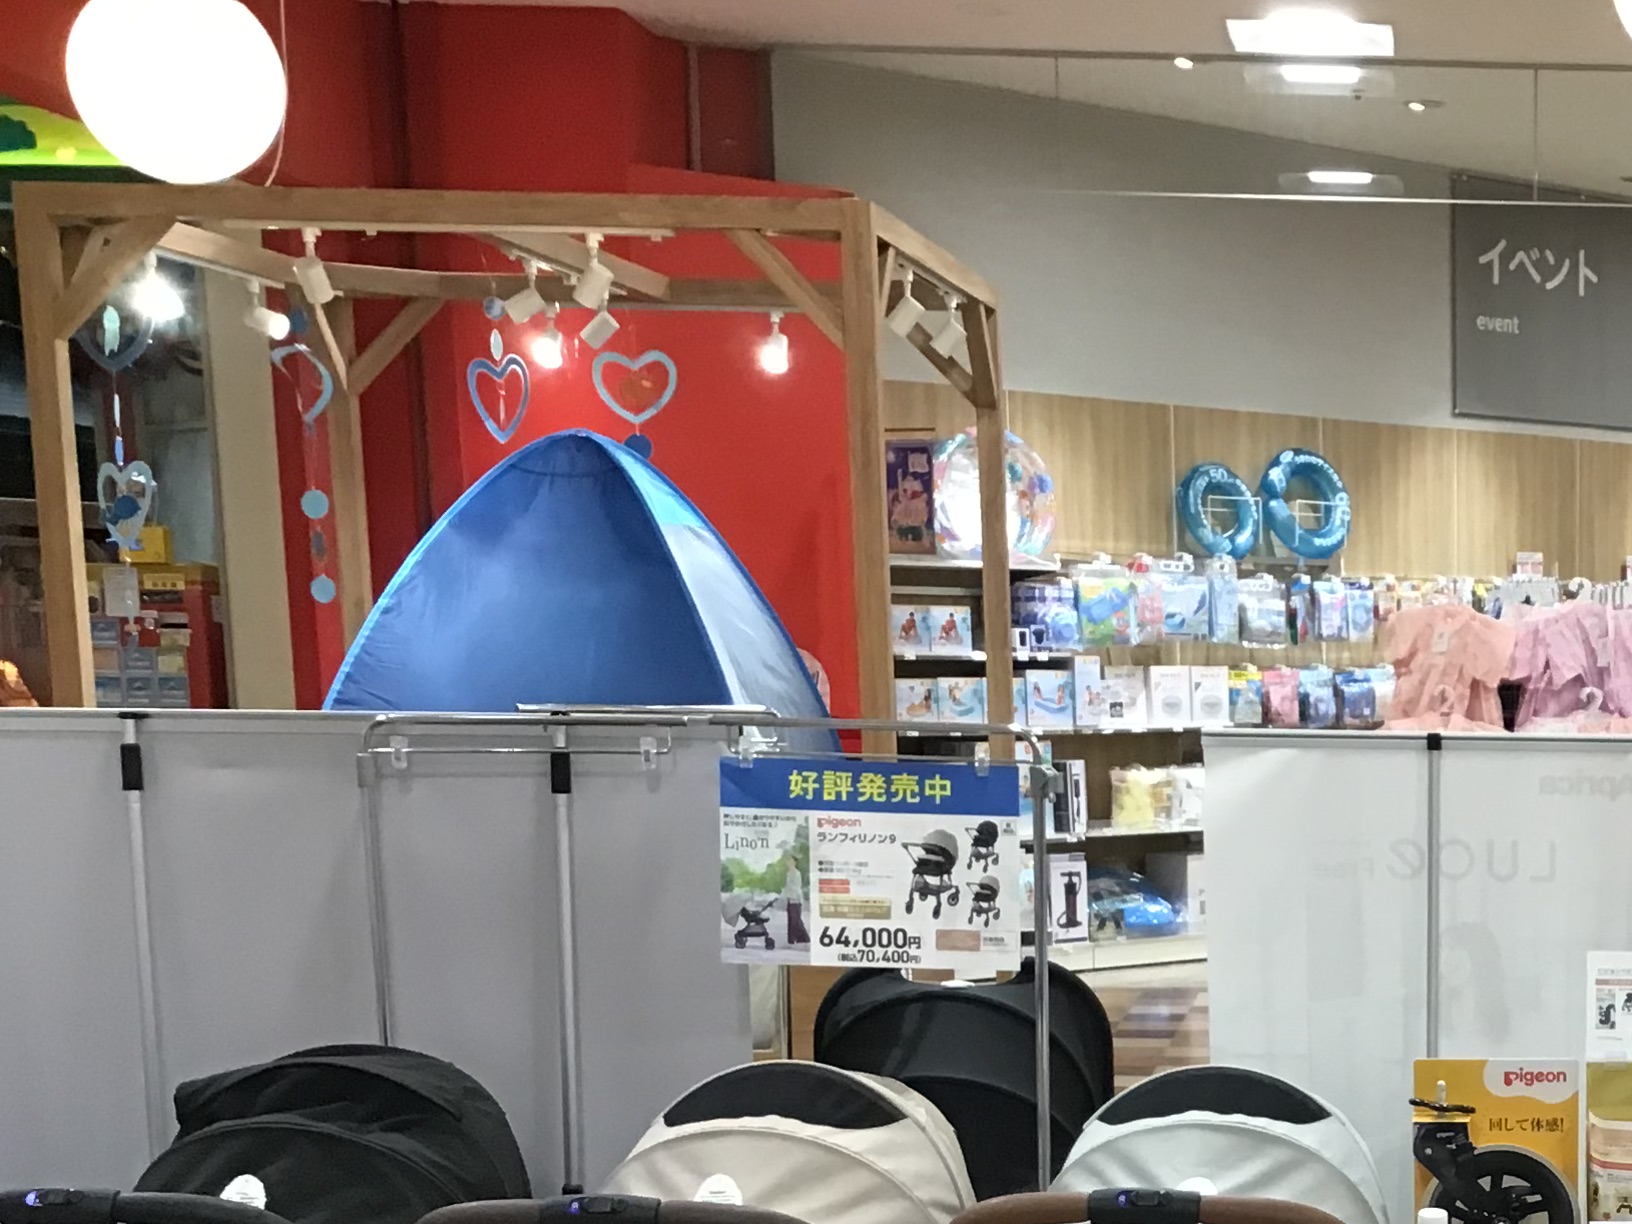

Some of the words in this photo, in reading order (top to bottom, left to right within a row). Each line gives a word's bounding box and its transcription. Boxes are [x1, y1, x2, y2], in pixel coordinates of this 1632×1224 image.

[1478, 239, 1599, 297] イベント
[1476, 315, 1520, 334] event
[789, 770, 952, 805] 好評発売中
[817, 816, 861, 829] pigeon
[817, 832, 896, 844] ランフィリノン9
[1503, 1068, 1567, 1086] pigeon
